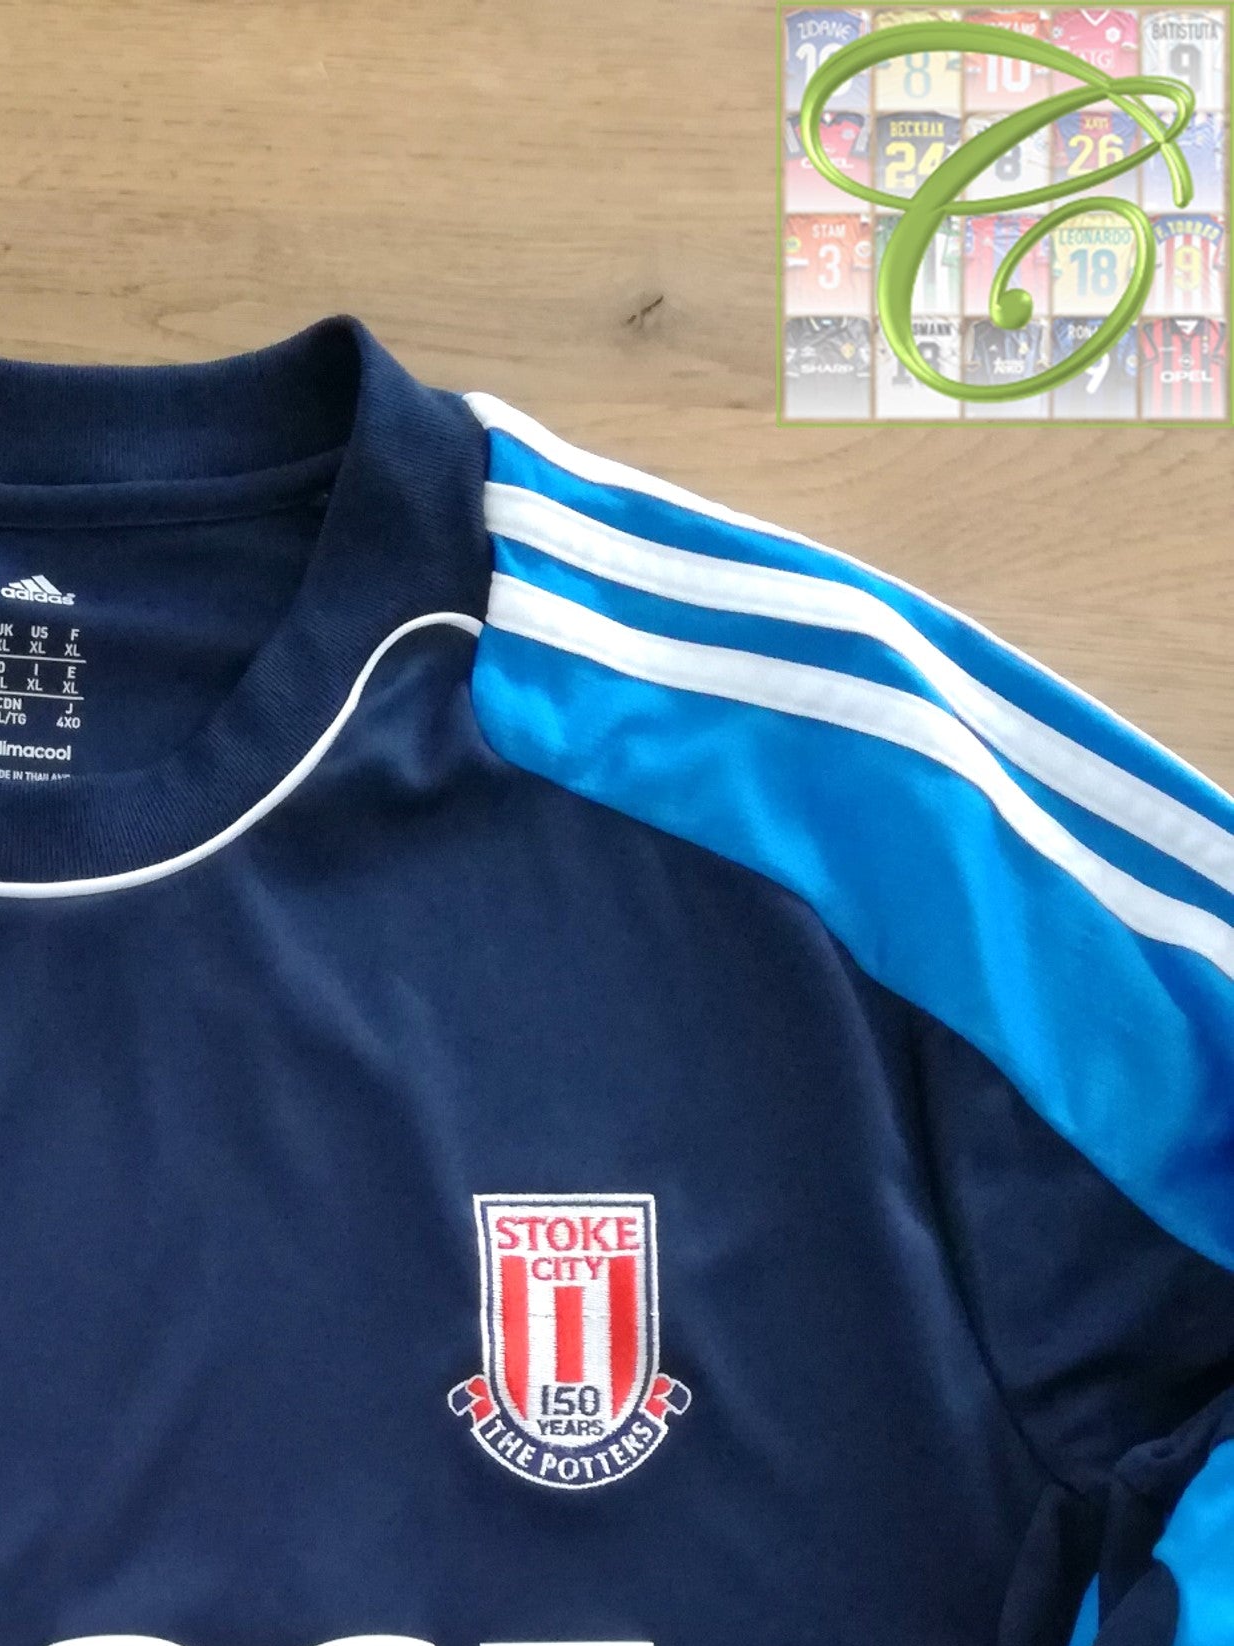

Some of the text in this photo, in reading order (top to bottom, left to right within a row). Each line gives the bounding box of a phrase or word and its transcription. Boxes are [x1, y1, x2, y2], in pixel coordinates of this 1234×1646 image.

[0, 586, 76, 606] adidas
[31, 626, 49, 640] US
[70, 629, 80, 641] F
[29, 641, 46, 655] XL
[64, 644, 81, 657] XL
[67, 666, 77, 679] E
[26, 678, 43, 692] XL
[62, 681, 78, 695] XL
[65, 703, 73, 715] J
[13, 771, 23, 780] IN
[495, 1215, 640, 1252] STOKE
[531, 1256, 604, 1281] CITY
[540, 1384, 601, 1417] 150
[535, 1418, 605, 1437] YEARS
[483, 1418, 654, 1481] THE POTTERS
